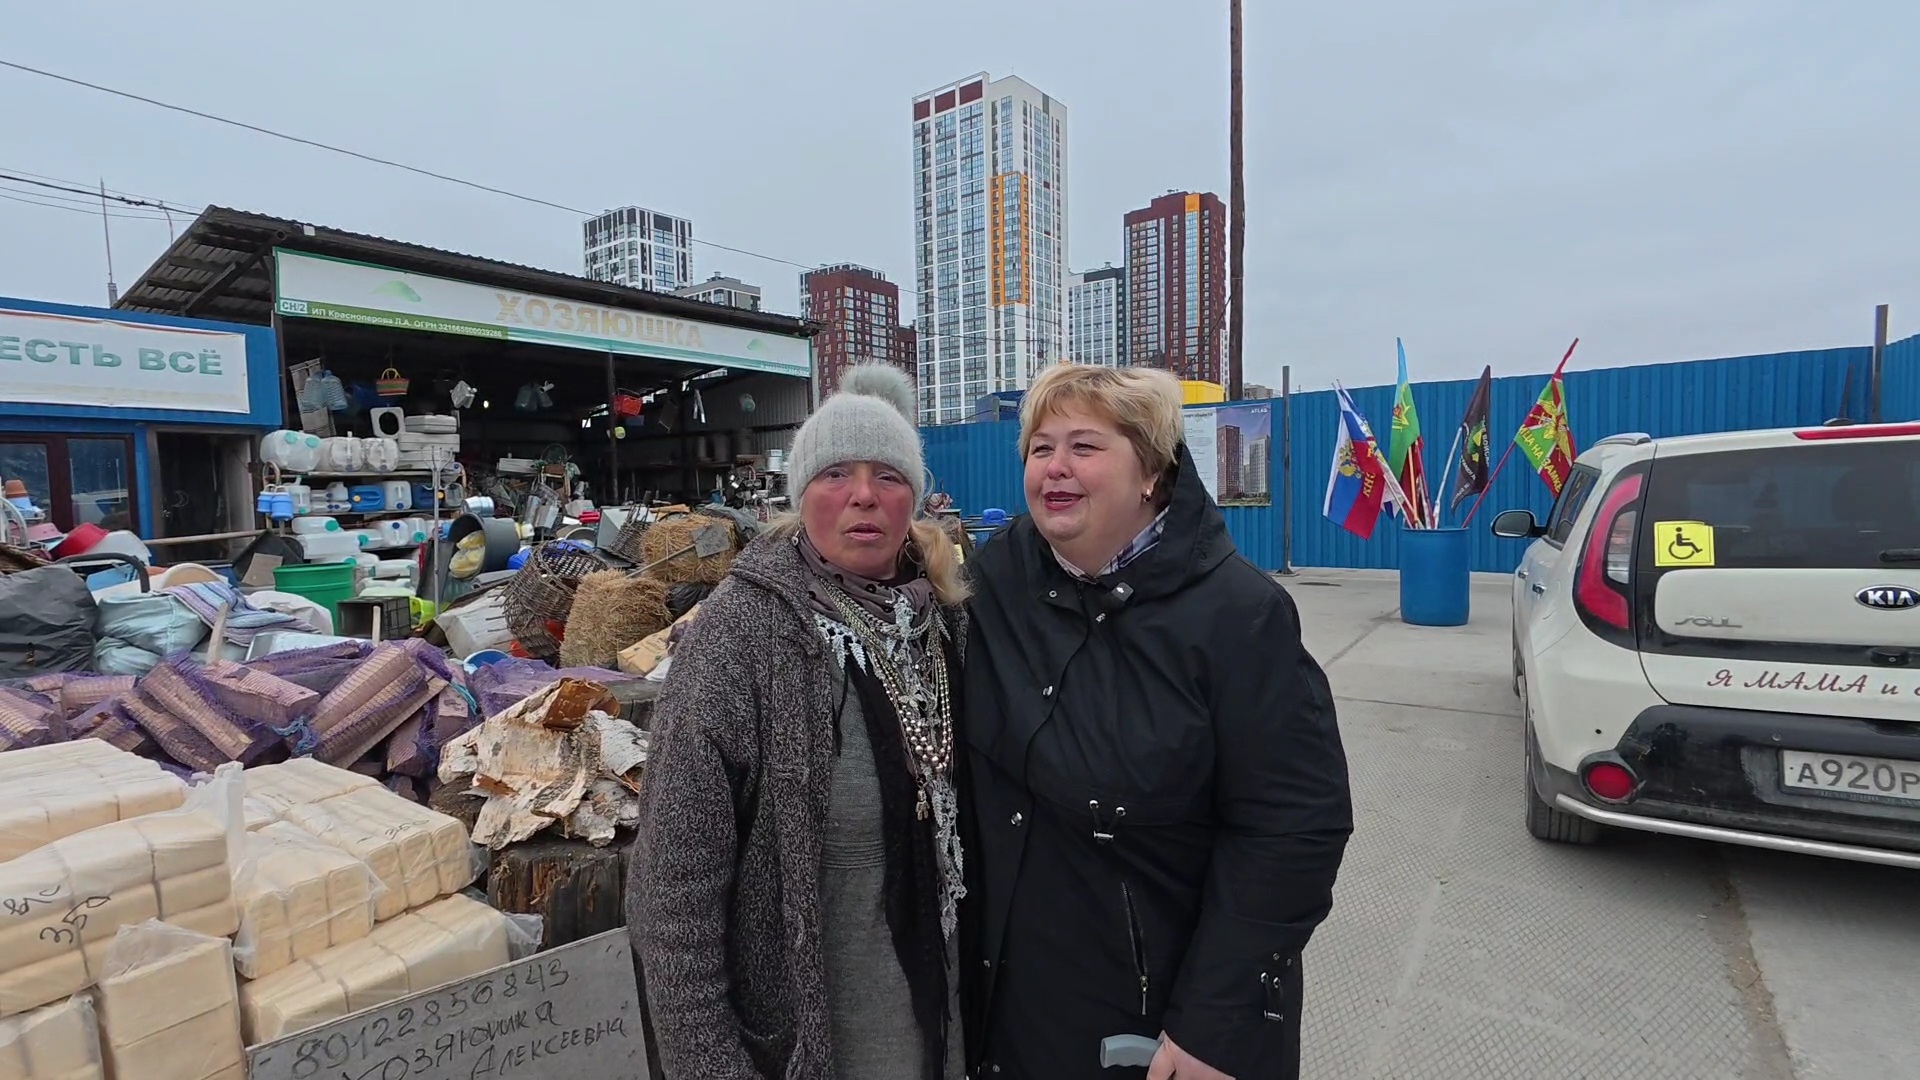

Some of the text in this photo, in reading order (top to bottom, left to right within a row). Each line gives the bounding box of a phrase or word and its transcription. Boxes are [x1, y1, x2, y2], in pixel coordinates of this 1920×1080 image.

[311, 307, 327, 316] ИП
[413, 319, 438, 329] ОГРН
[494, 292, 704, 348] ХОЗЯЮШКА
[0, 336, 223, 375] ЕСТЬ ВСЁ
[1541, 457, 1563, 493] ЗАМКЕ
[1866, 590, 1915, 606] KIA
[1706, 668, 1733, 687] Я
[1743, 670, 1868, 694] МАМА
[1880, 683, 1899, 695] и
[40, 896, 111, 945] 350
